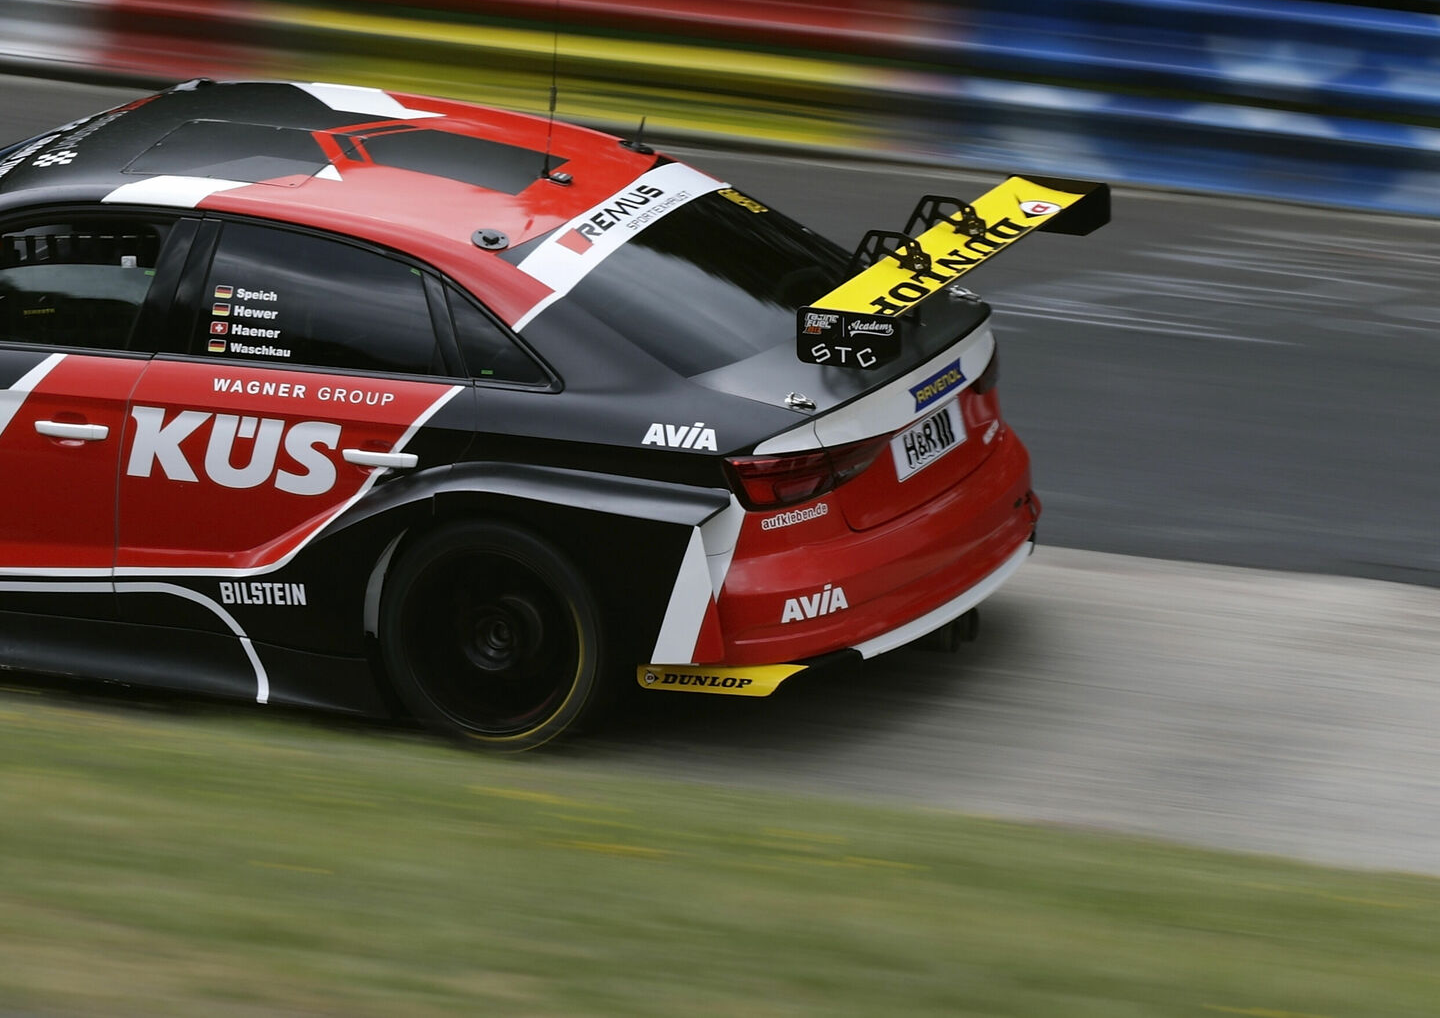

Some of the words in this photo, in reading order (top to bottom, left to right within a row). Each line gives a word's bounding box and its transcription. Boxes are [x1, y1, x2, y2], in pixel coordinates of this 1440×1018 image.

[574, 184, 665, 243] REMUS
[869, 217, 1033, 316] DUNLOP
[236, 287, 278, 302] Speich
[233, 305, 278, 320] Hewer
[231, 323, 281, 339] Haener
[229, 342, 291, 358] Waschkau
[811, 343, 877, 368] STC
[212, 378, 306, 399] WAGNER
[317, 386, 394, 407] GROUP
[916, 368, 962, 404] RAVENOL
[126, 405, 342, 496] KÜS
[762, 503, 829, 530] aufkleben.de
[219, 582, 307, 606] BILSTEIN
[661, 673, 753, 689] DUNLOP
